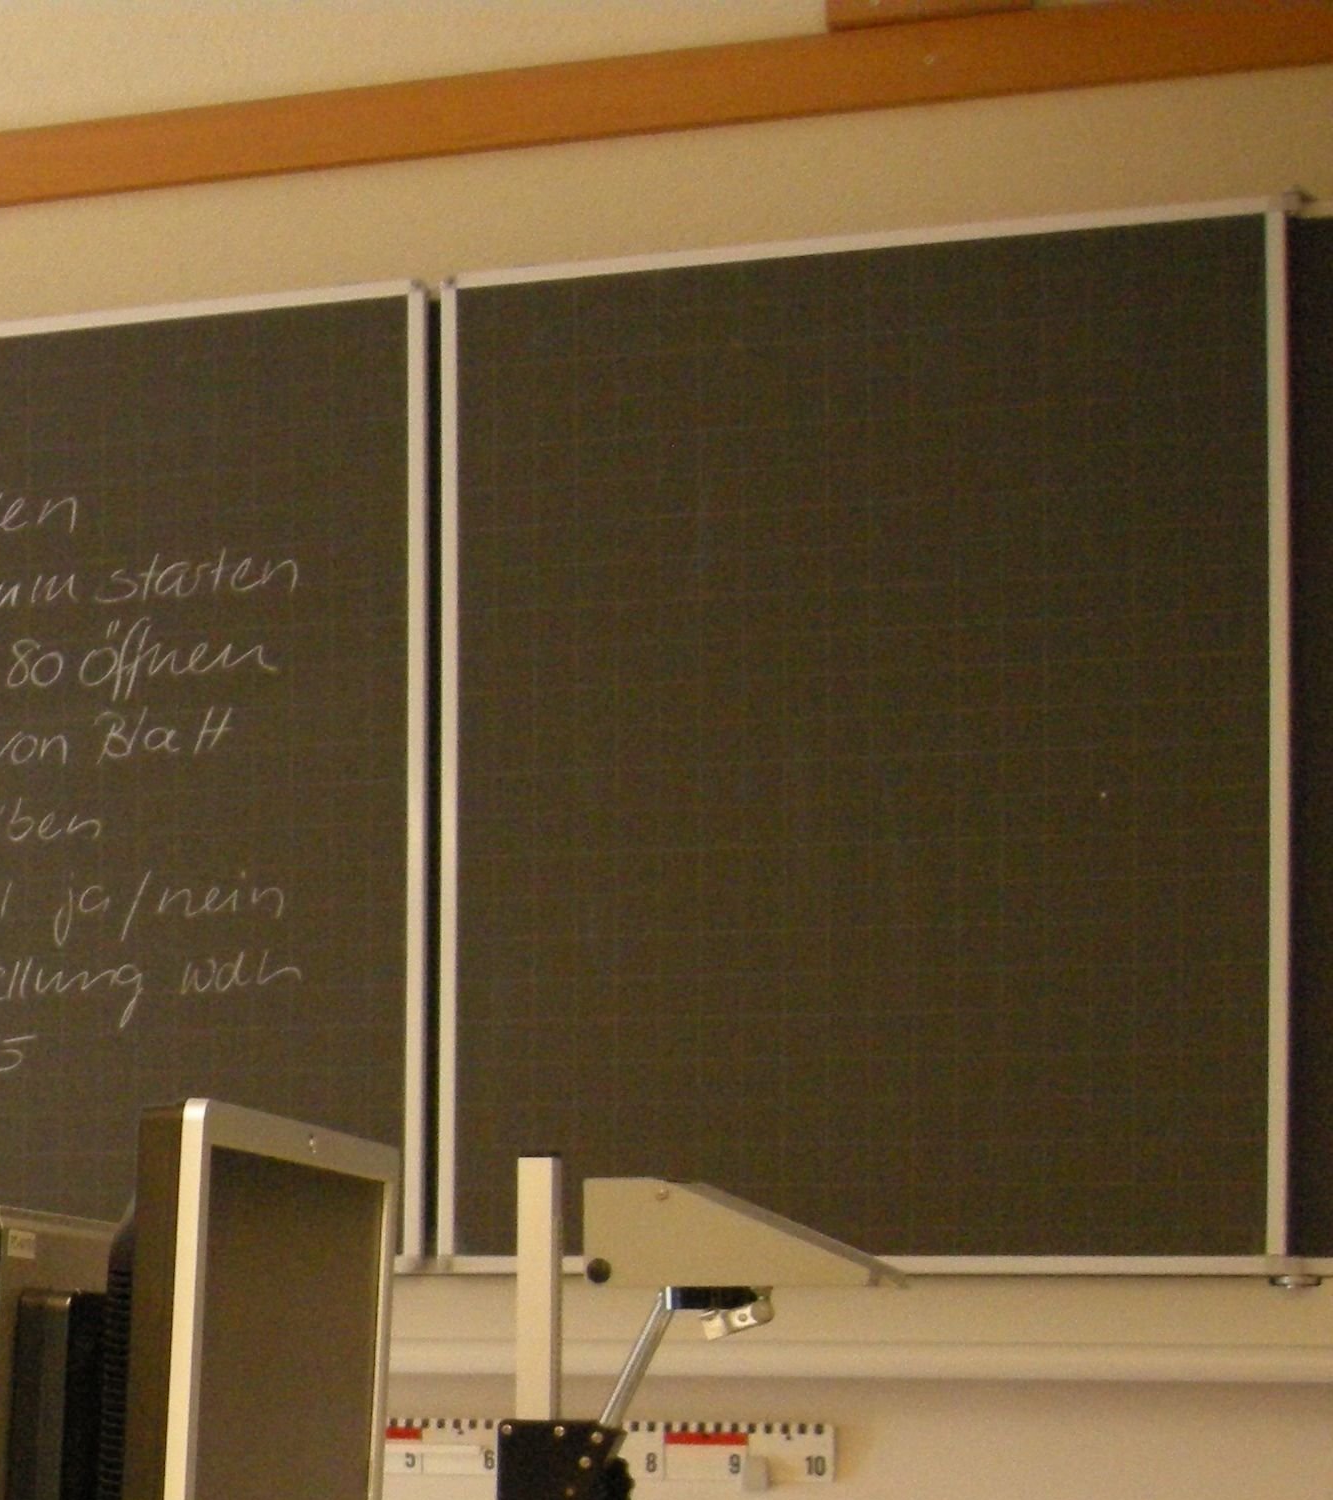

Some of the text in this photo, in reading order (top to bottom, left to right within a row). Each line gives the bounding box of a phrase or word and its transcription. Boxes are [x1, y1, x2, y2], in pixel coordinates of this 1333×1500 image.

[93, 547, 300, 604] starten
[6, 638, 63, 689] 80
[96, 706, 234, 765] Blatt
[645, 1452, 658, 1473] 8
[728, 1453, 741, 1474] 9
[805, 1455, 826, 1477] 10
